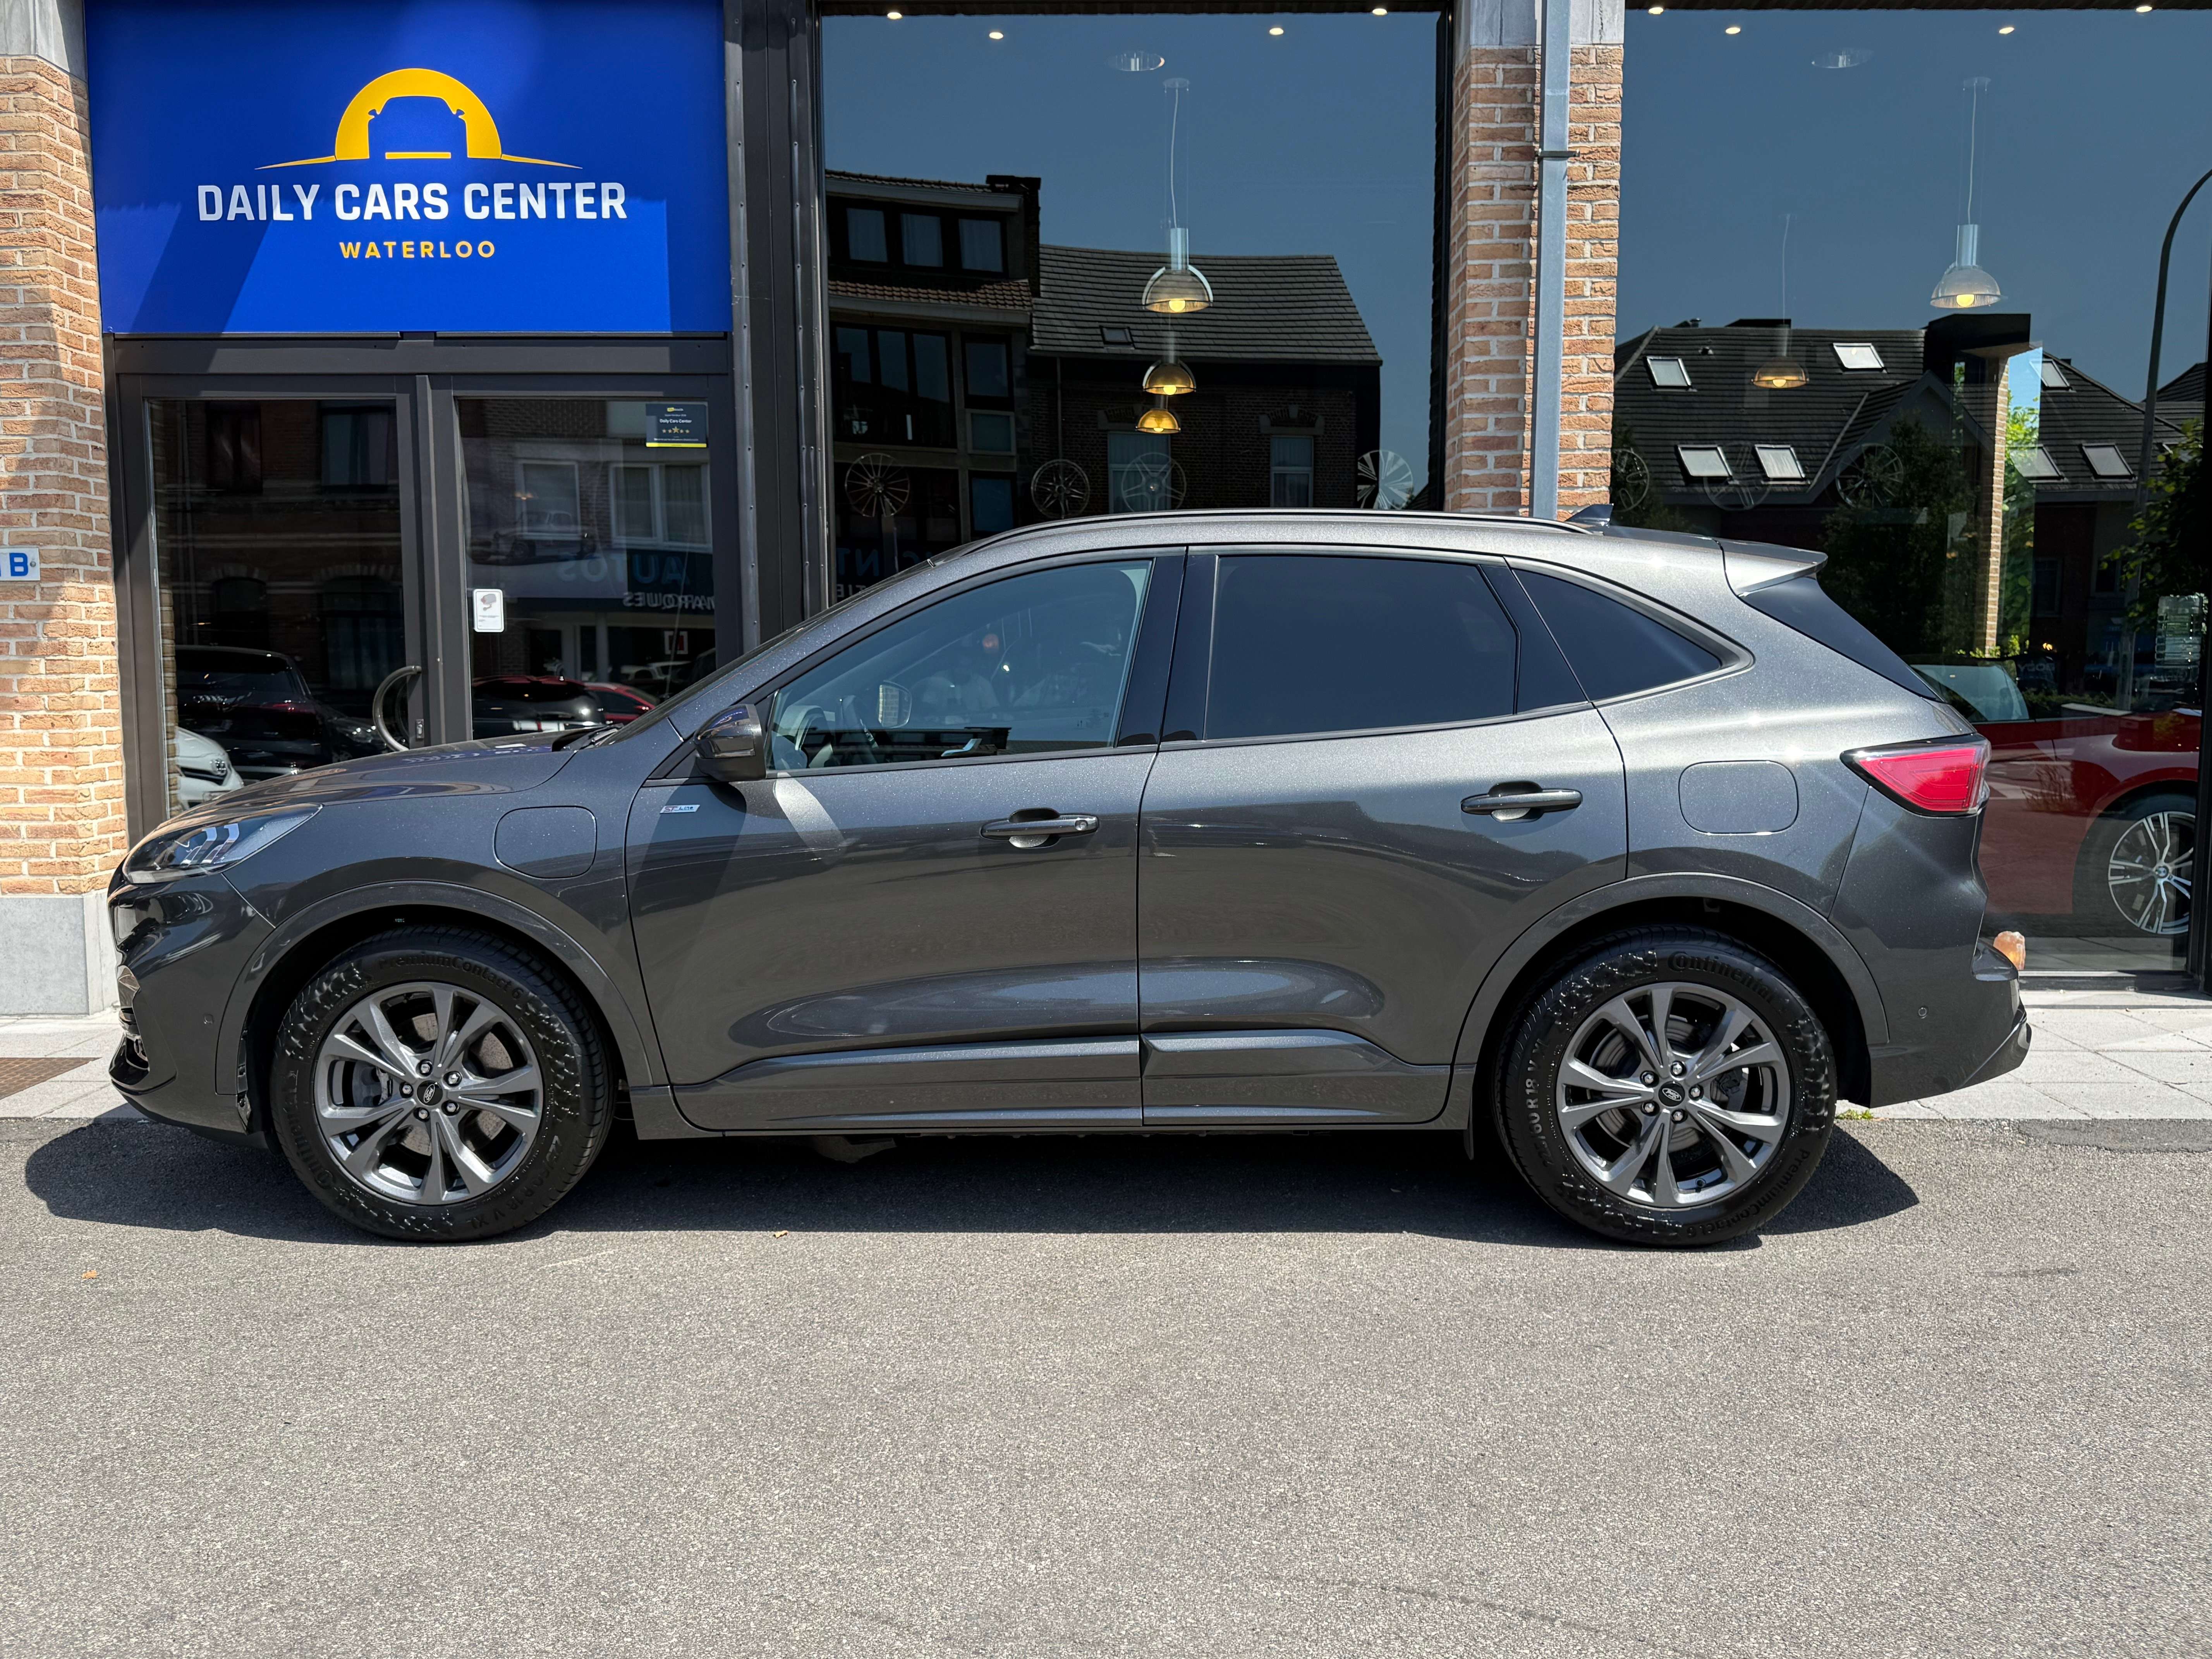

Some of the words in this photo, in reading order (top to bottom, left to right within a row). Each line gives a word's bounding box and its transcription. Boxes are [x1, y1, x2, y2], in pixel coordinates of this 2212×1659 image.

[198, 184, 320, 222] DAILY
[335, 182, 449, 221] CARS
[464, 182, 627, 220] CENTER
[340, 240, 495, 259] WATERLOO
